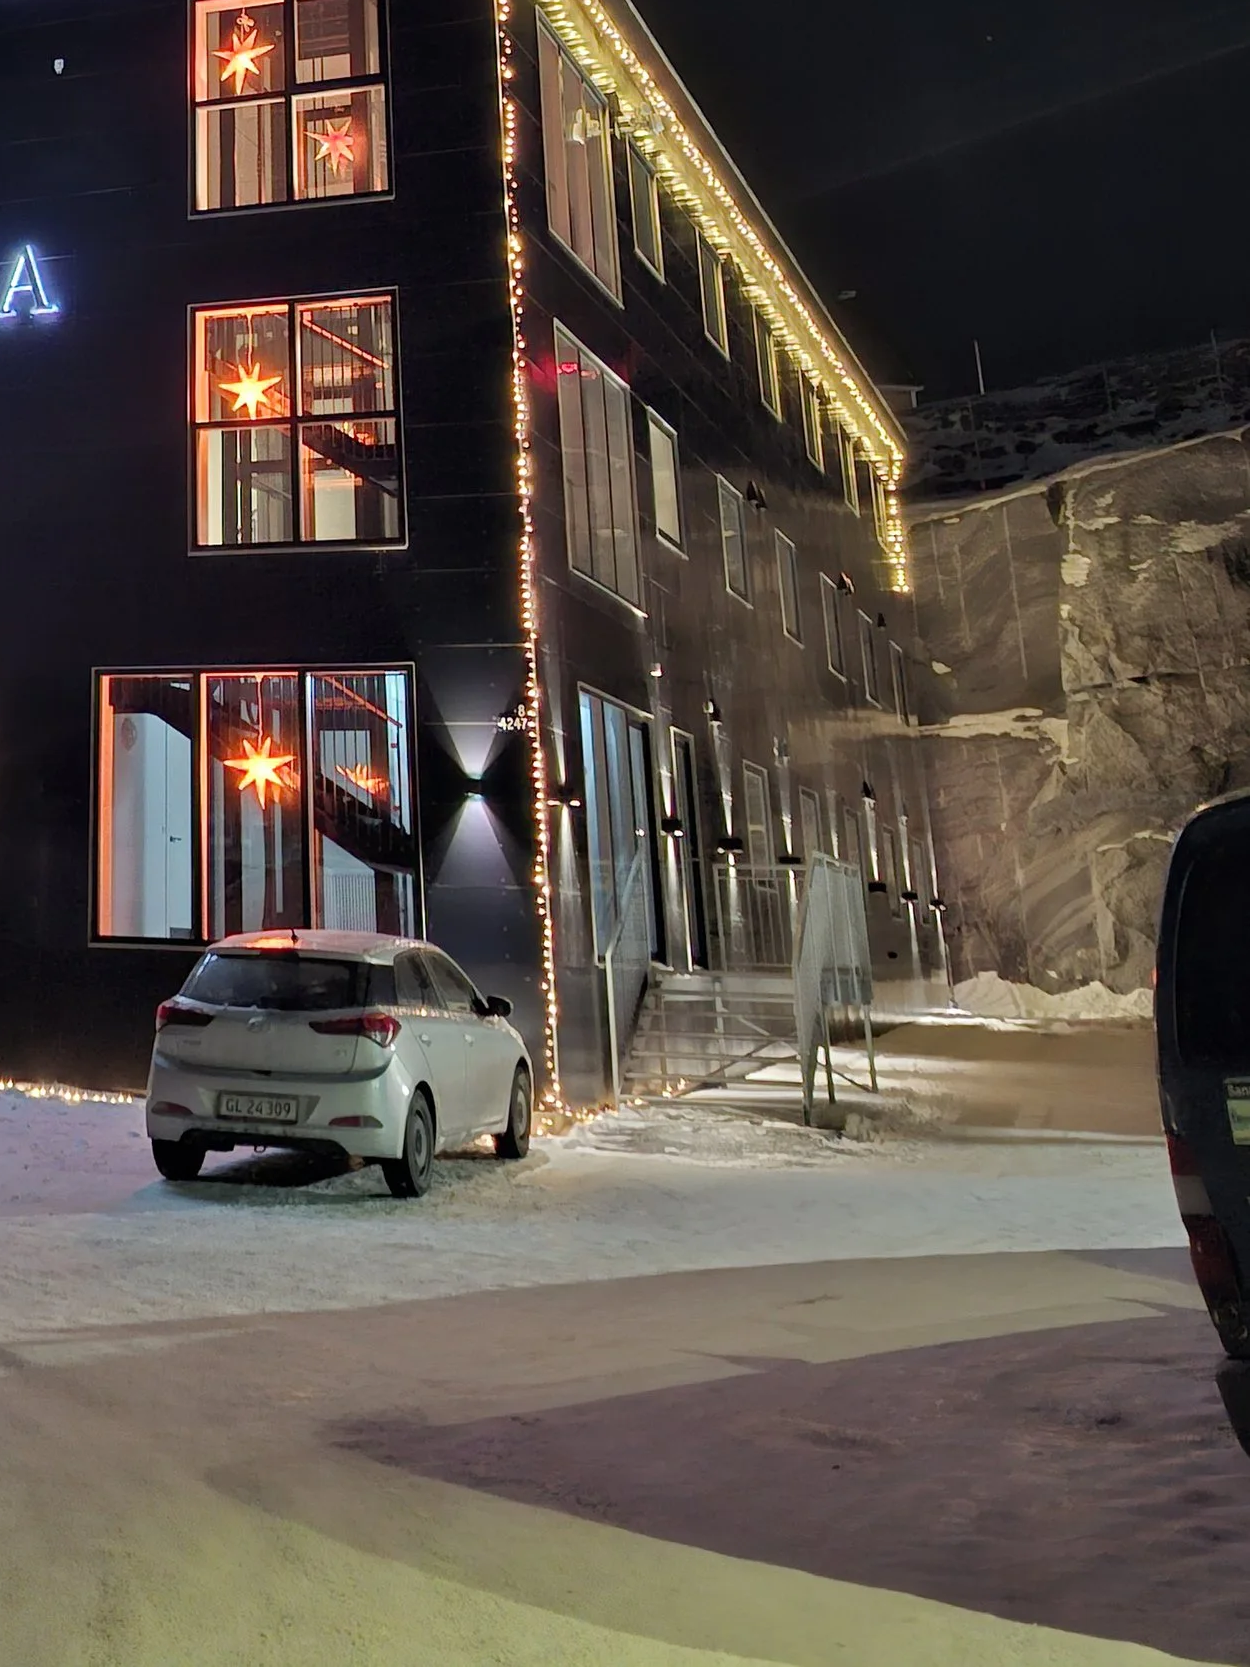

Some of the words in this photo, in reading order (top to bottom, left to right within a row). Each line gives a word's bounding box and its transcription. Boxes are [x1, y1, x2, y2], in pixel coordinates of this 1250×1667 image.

[517, 703, 526, 717] 8
[497, 717, 528, 731] 4247
[225, 1097, 243, 1114] GL
